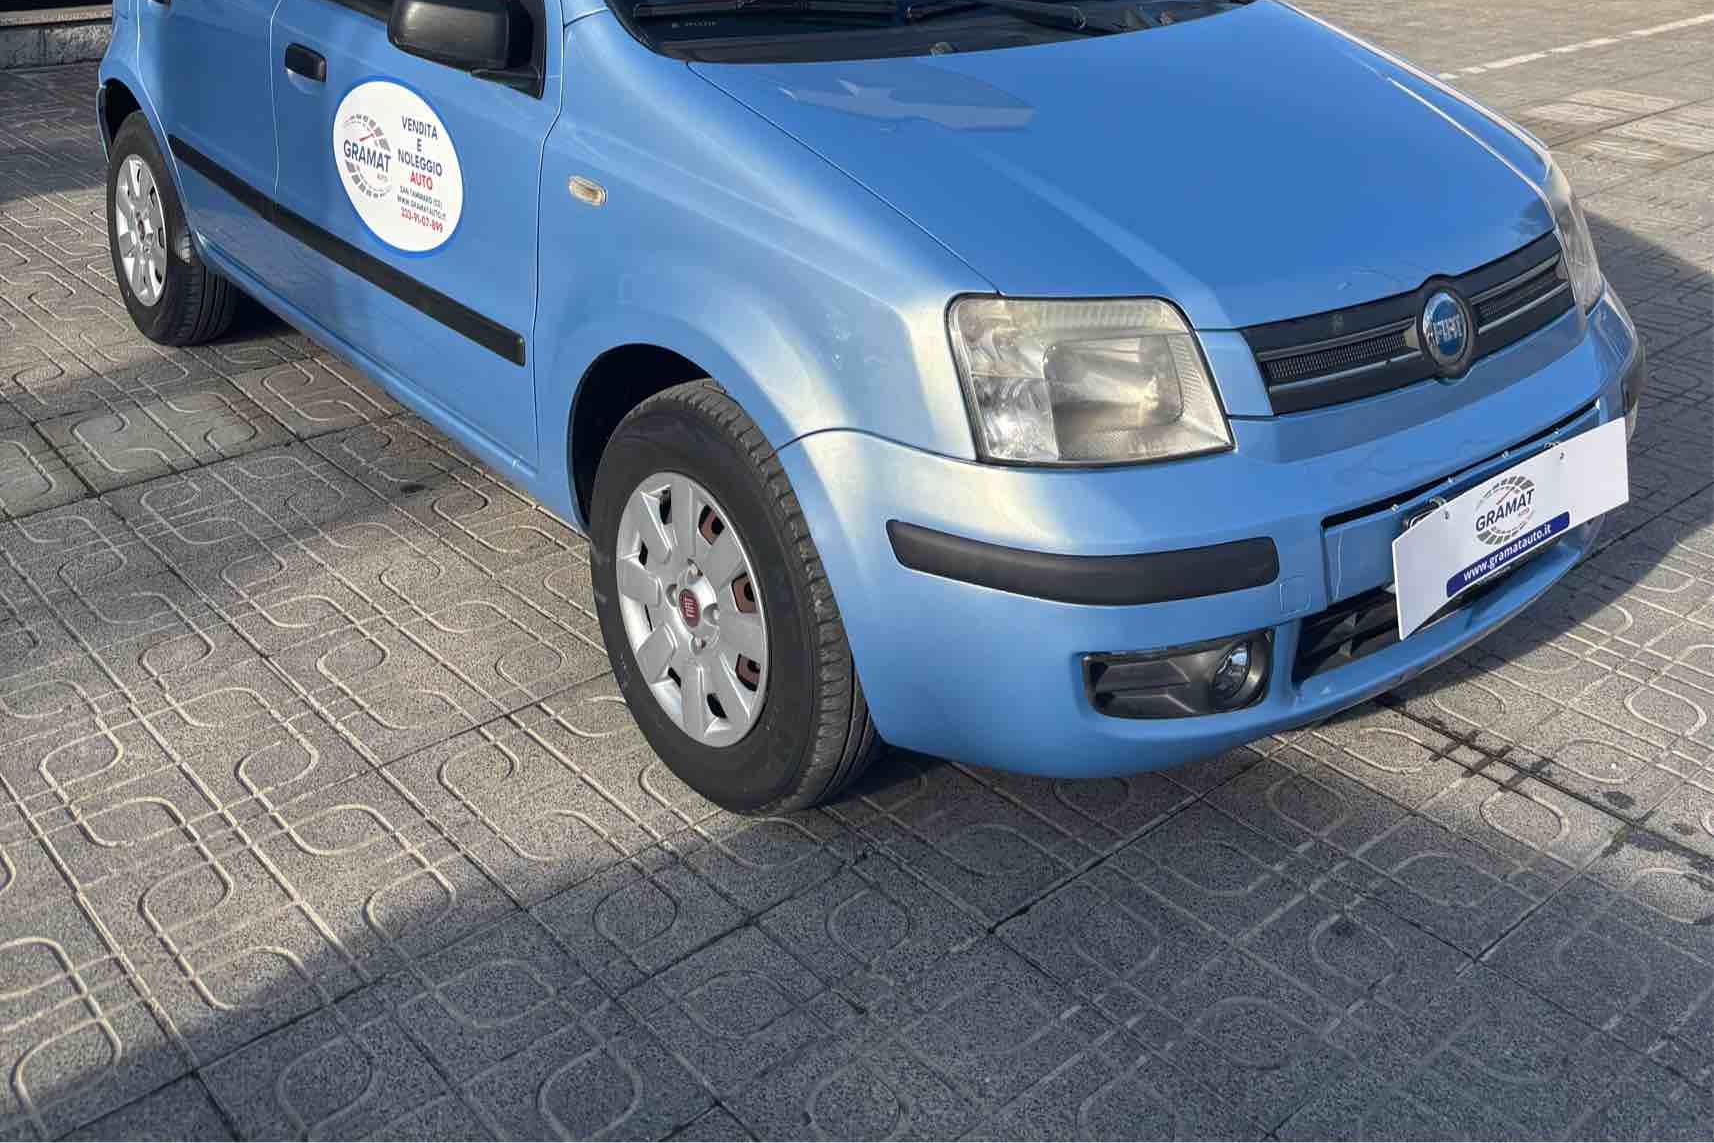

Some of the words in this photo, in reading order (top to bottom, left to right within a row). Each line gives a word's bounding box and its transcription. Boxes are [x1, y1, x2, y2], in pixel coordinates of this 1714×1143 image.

[401, 115, 438, 139] VENDITA
[343, 139, 392, 173] GRAMAT
[416, 138, 423, 152] E
[398, 148, 443, 177] NOLEGGIO
[410, 172, 433, 191] AUTO
[1475, 489, 1535, 532] GRAMAT
[1462, 523, 1552, 582] www.gramatauto.it
